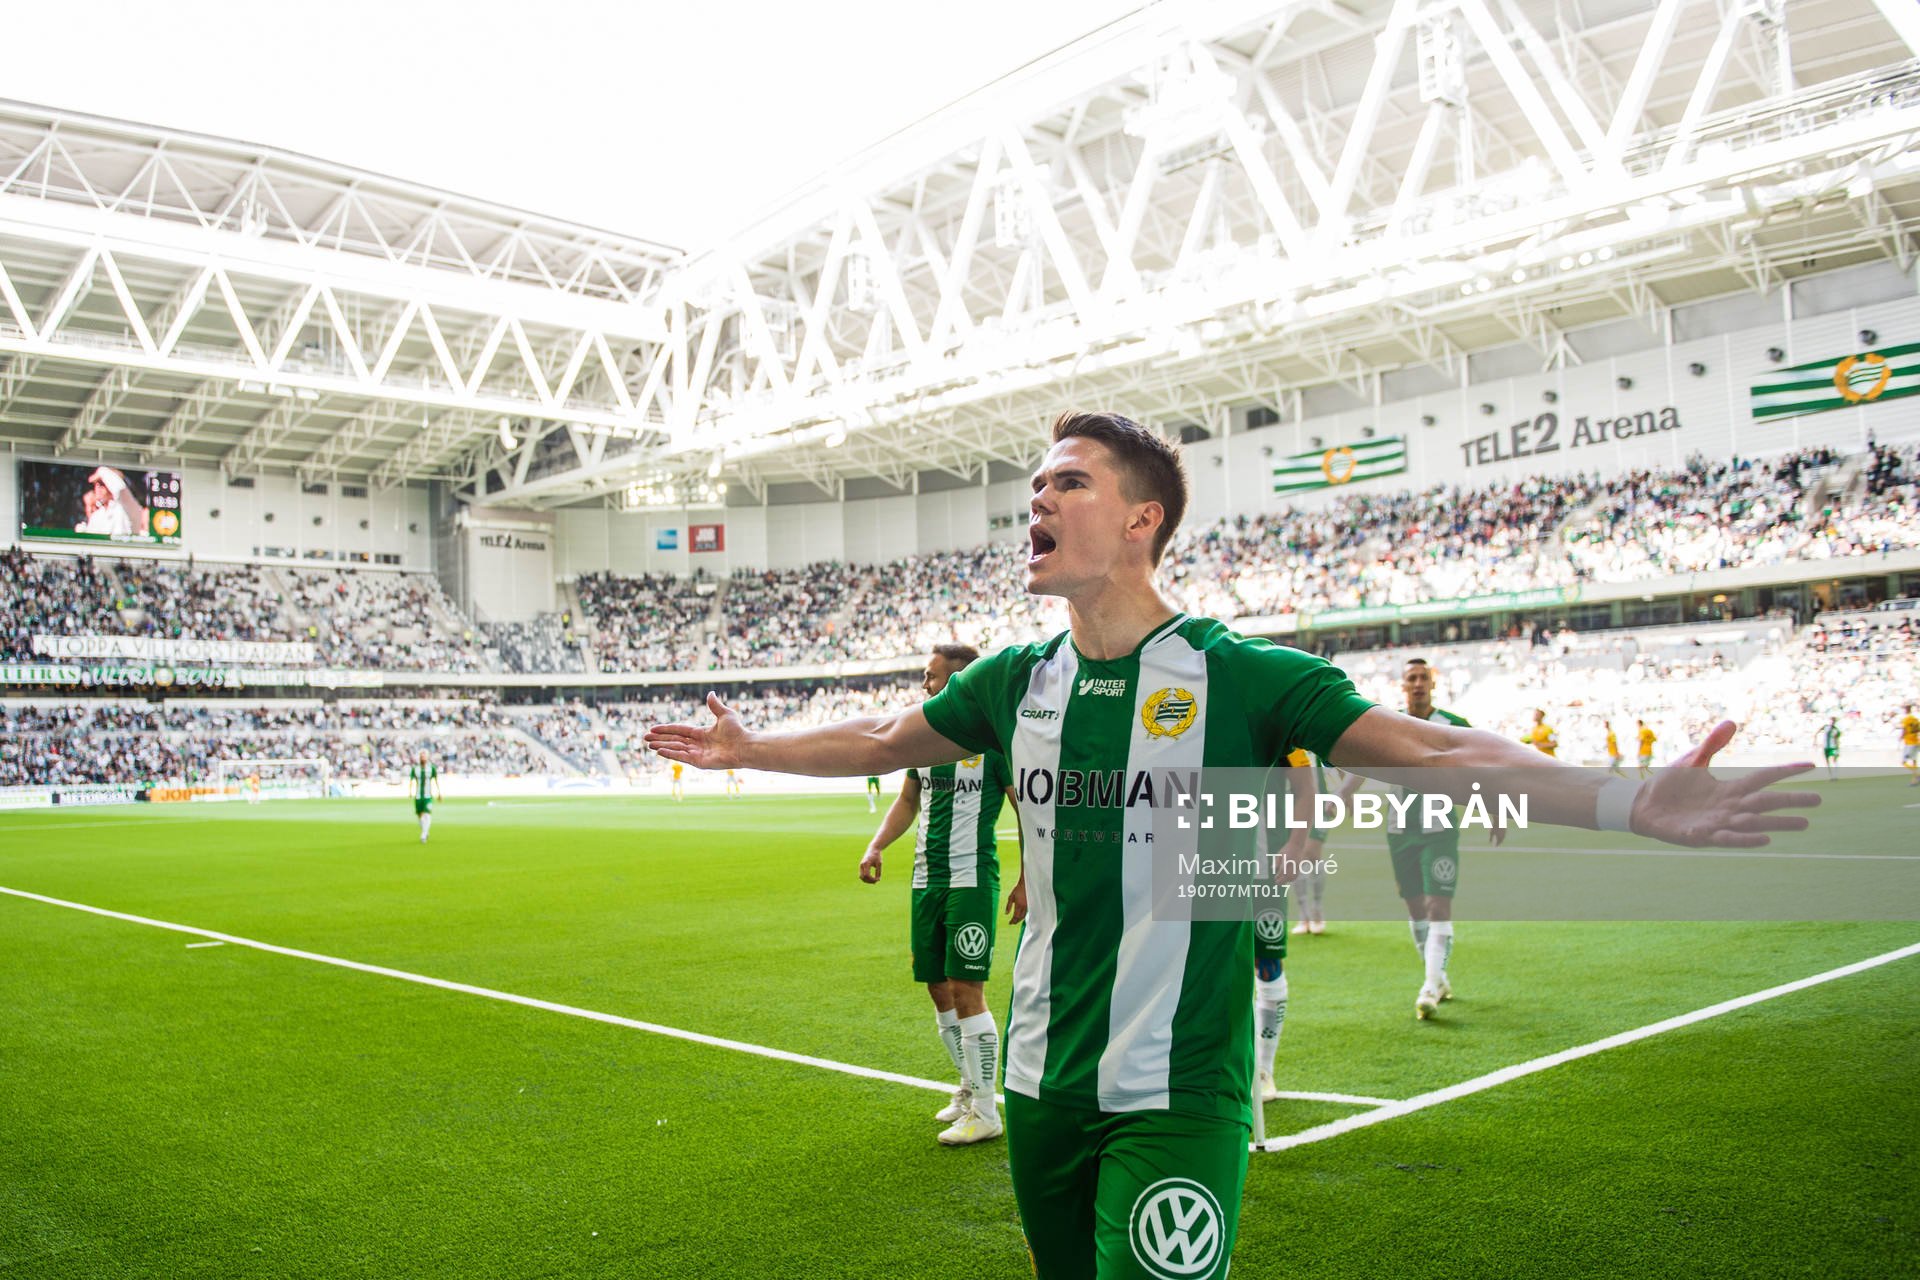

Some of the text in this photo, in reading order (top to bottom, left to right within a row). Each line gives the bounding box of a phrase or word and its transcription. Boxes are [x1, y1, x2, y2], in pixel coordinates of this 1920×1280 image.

[1460, 405, 1682, 467] TELE2 Arena
[480, 534, 512, 549] TELE2
[39, 639, 122, 657] STOPPA
[1092, 687, 1126, 697] SPORT
[1095, 679, 1126, 689] INTER
[1021, 709, 1056, 720] CRAFT
[920, 776, 982, 793] OBMAN
[1016, 767, 1199, 809] JOBMAN
[1037, 828, 1155, 843] WORKWEAR
[979, 1032, 998, 1080] Clinton
